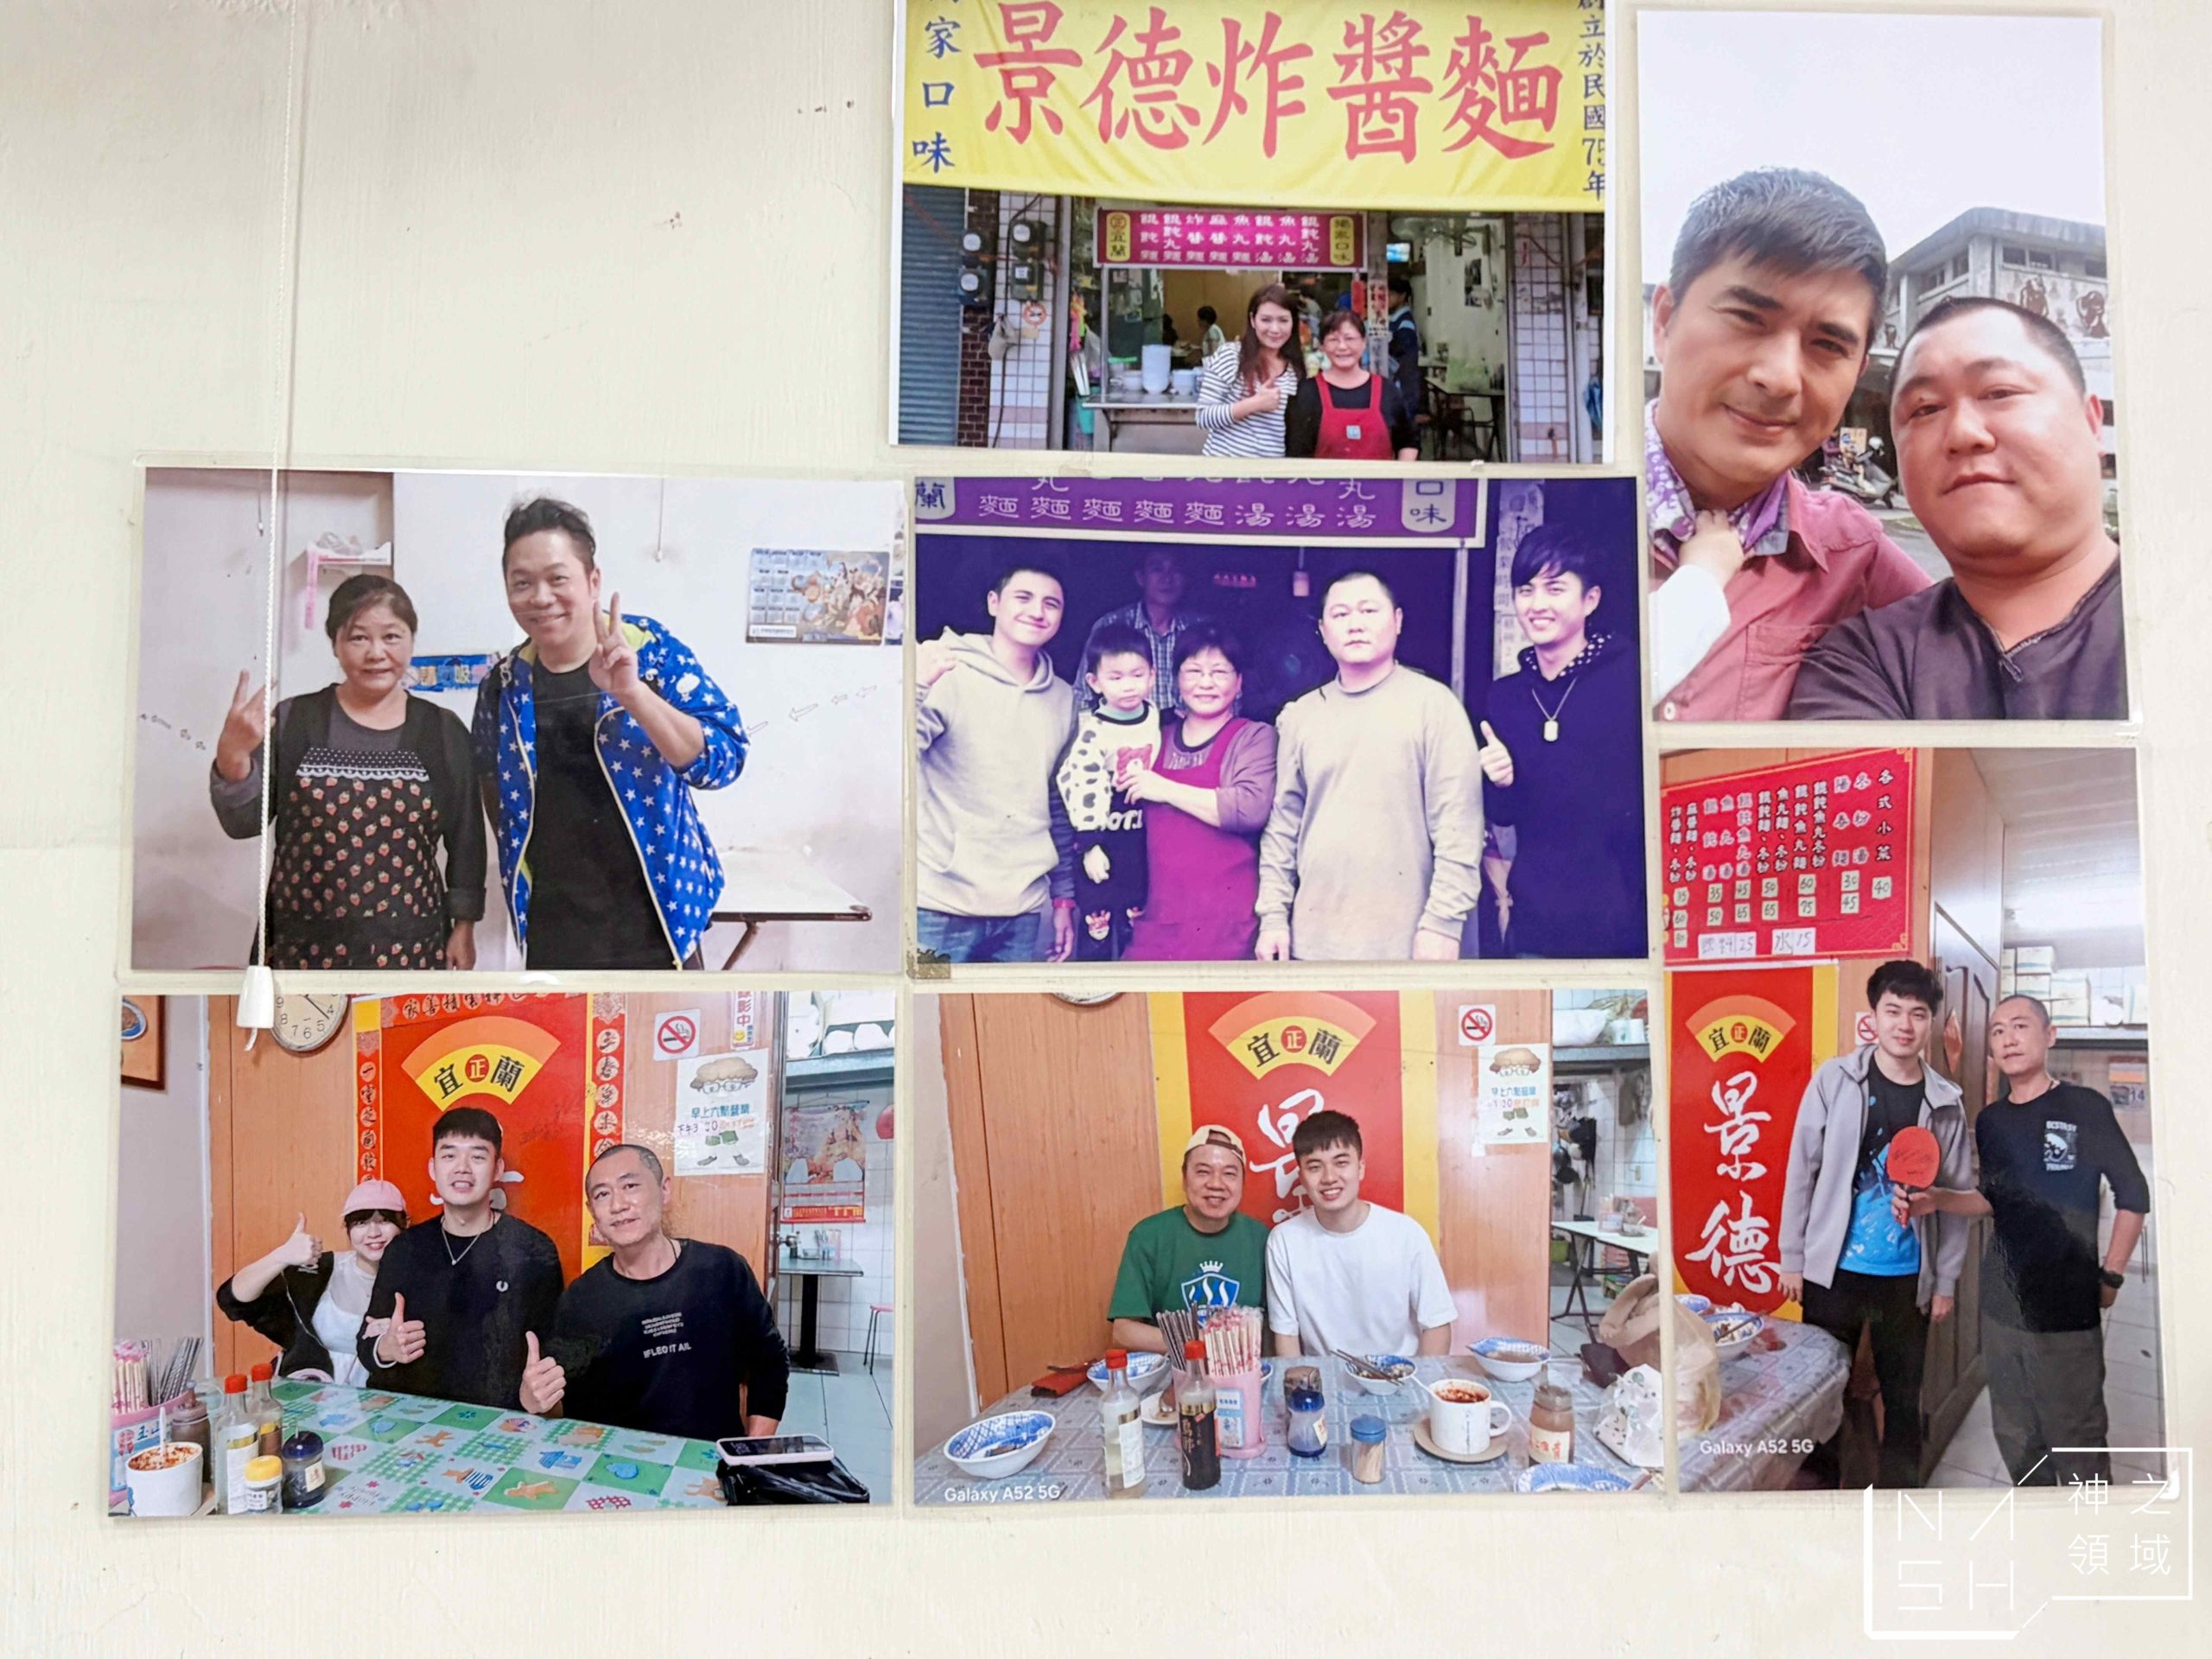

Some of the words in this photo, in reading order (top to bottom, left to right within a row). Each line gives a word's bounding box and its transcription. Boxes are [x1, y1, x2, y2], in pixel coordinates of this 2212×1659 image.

[912, 0, 962, 174] 家口味
[974, 2, 1563, 162] 景德炸醬麵
[1410, 480, 1447, 524] 口味
[1876, 768, 1894, 861] 各式小菜
[276, 996, 284, 1009] 9
[327, 1004, 334, 1014] 4
[280, 1013, 288, 1025] 8
[316, 1020, 326, 1032] 5
[291, 1025, 298, 1037] 7
[303, 1027, 312, 1039] 6
[1685, 1071, 1782, 1294] 景德
[1700, 1440, 1753, 1458] Galaxy
[1757, 1439, 1788, 1454] A52
[1791, 1439, 1815, 1453] 5G
[944, 1487, 999, 1503] Galaxy
[1003, 1485, 1033, 1500] A52
[1038, 1484, 1061, 1500] 5G
